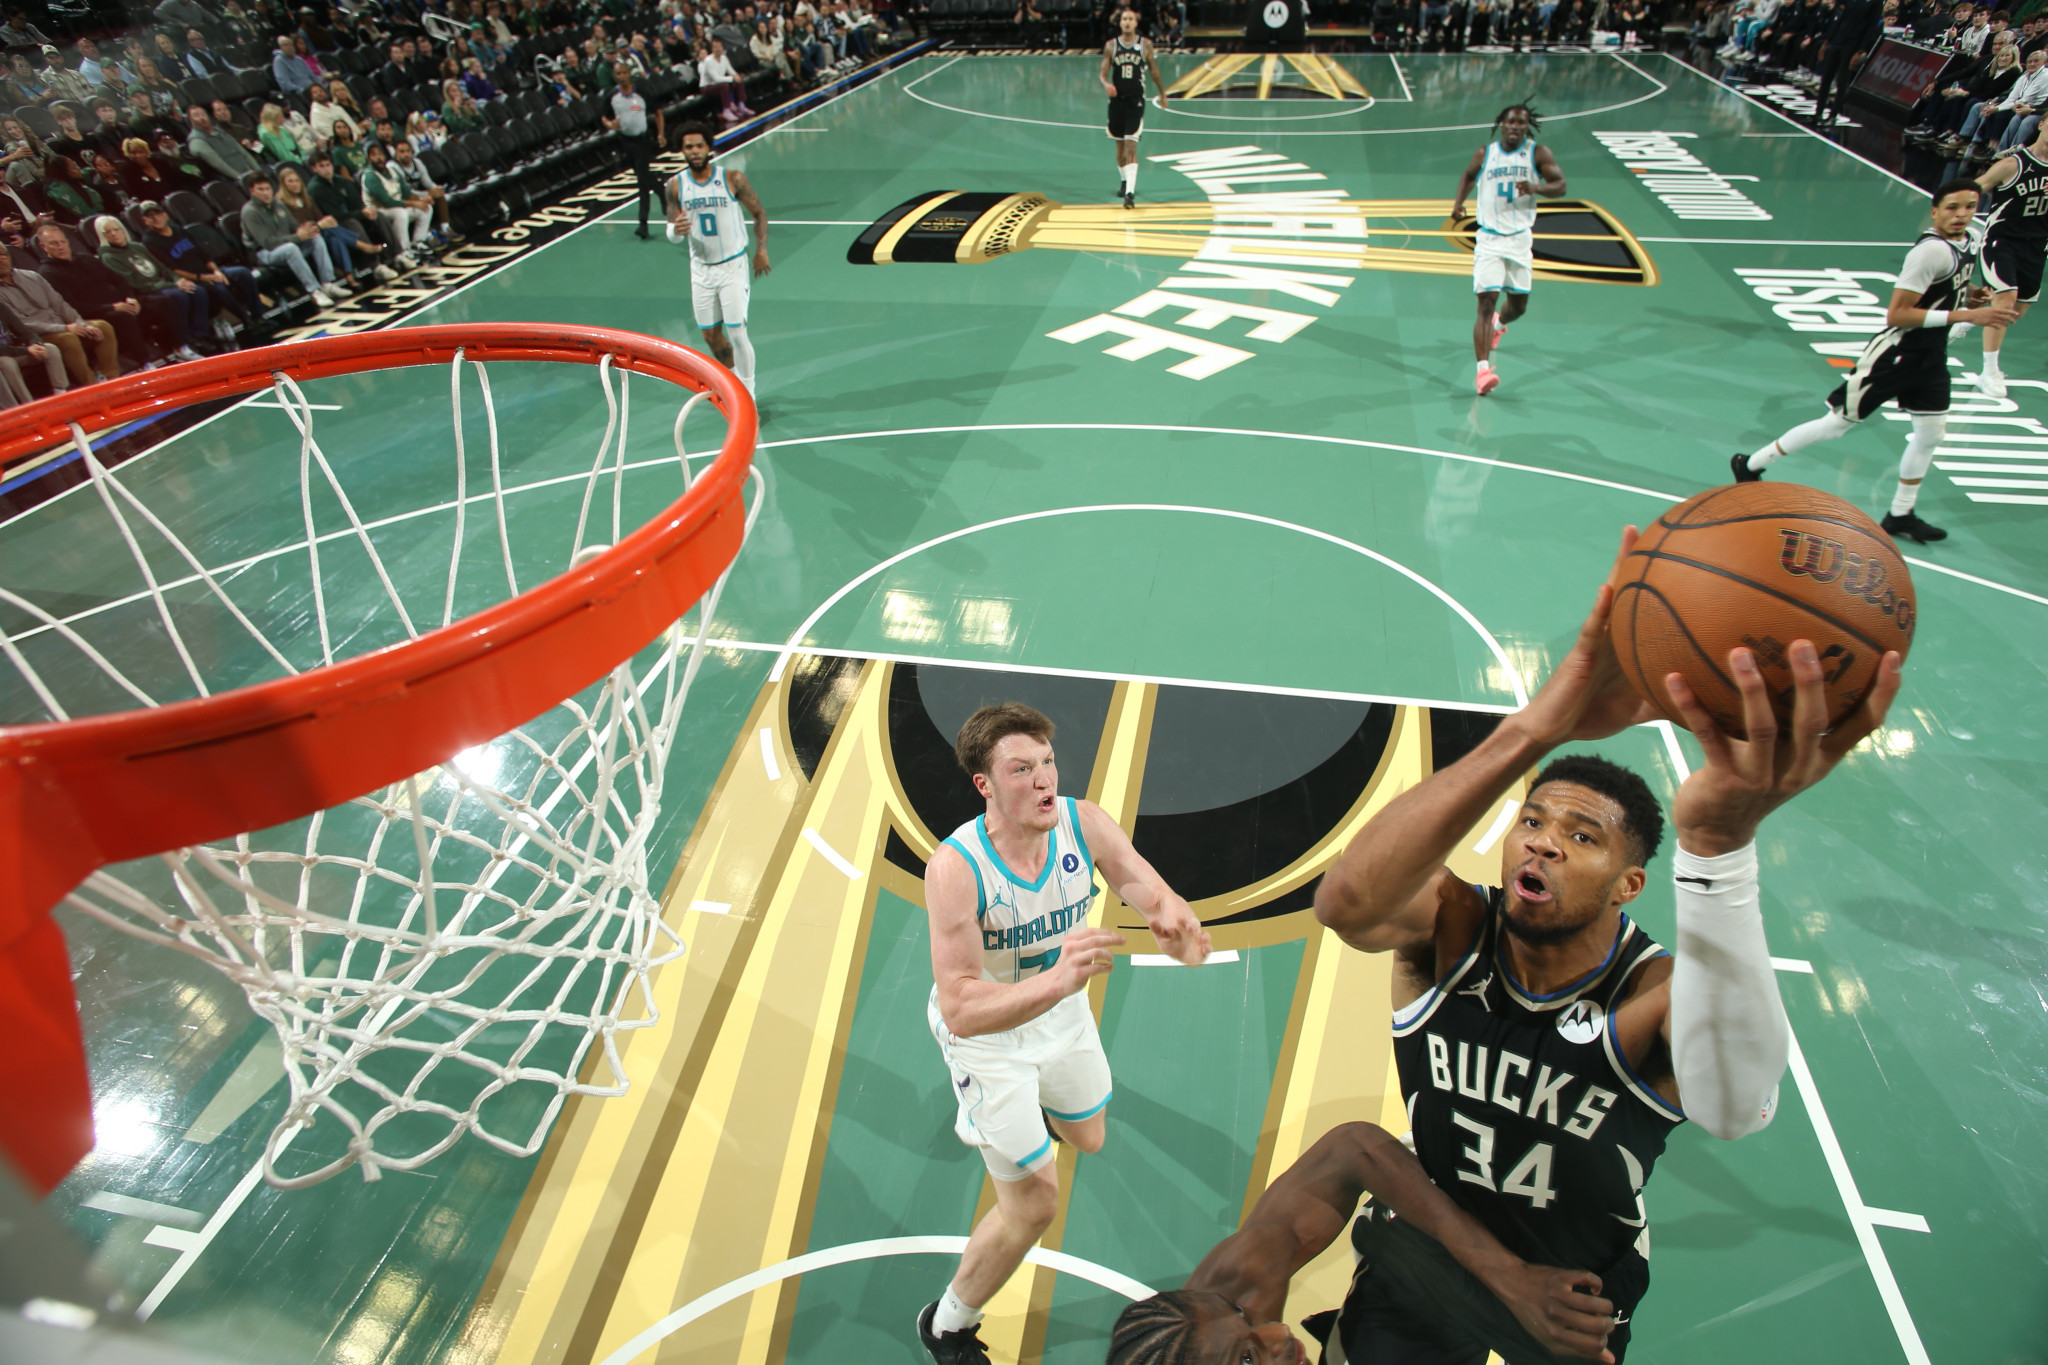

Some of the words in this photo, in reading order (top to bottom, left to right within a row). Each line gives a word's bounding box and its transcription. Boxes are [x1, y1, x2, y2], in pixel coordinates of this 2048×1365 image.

[1114, 52, 1141, 66] BUCKS
[1121, 64, 1134, 79] 18
[1868, 54, 1934, 92] KOHL'S
[1486, 166, 1528, 181] CHARLOTTE
[684, 196, 728, 211] CHARLOTTE
[1497, 181, 1515, 204] 4
[491, 205, 589, 242] the
[699, 213, 718, 237] 0
[1045, 145, 1368, 381] MILWAUKEE
[983, 895, 1090, 950] CHARLOTTE
[1426, 1031, 1619, 1141] BUCKS
[1451, 1107, 1559, 1210] 34
